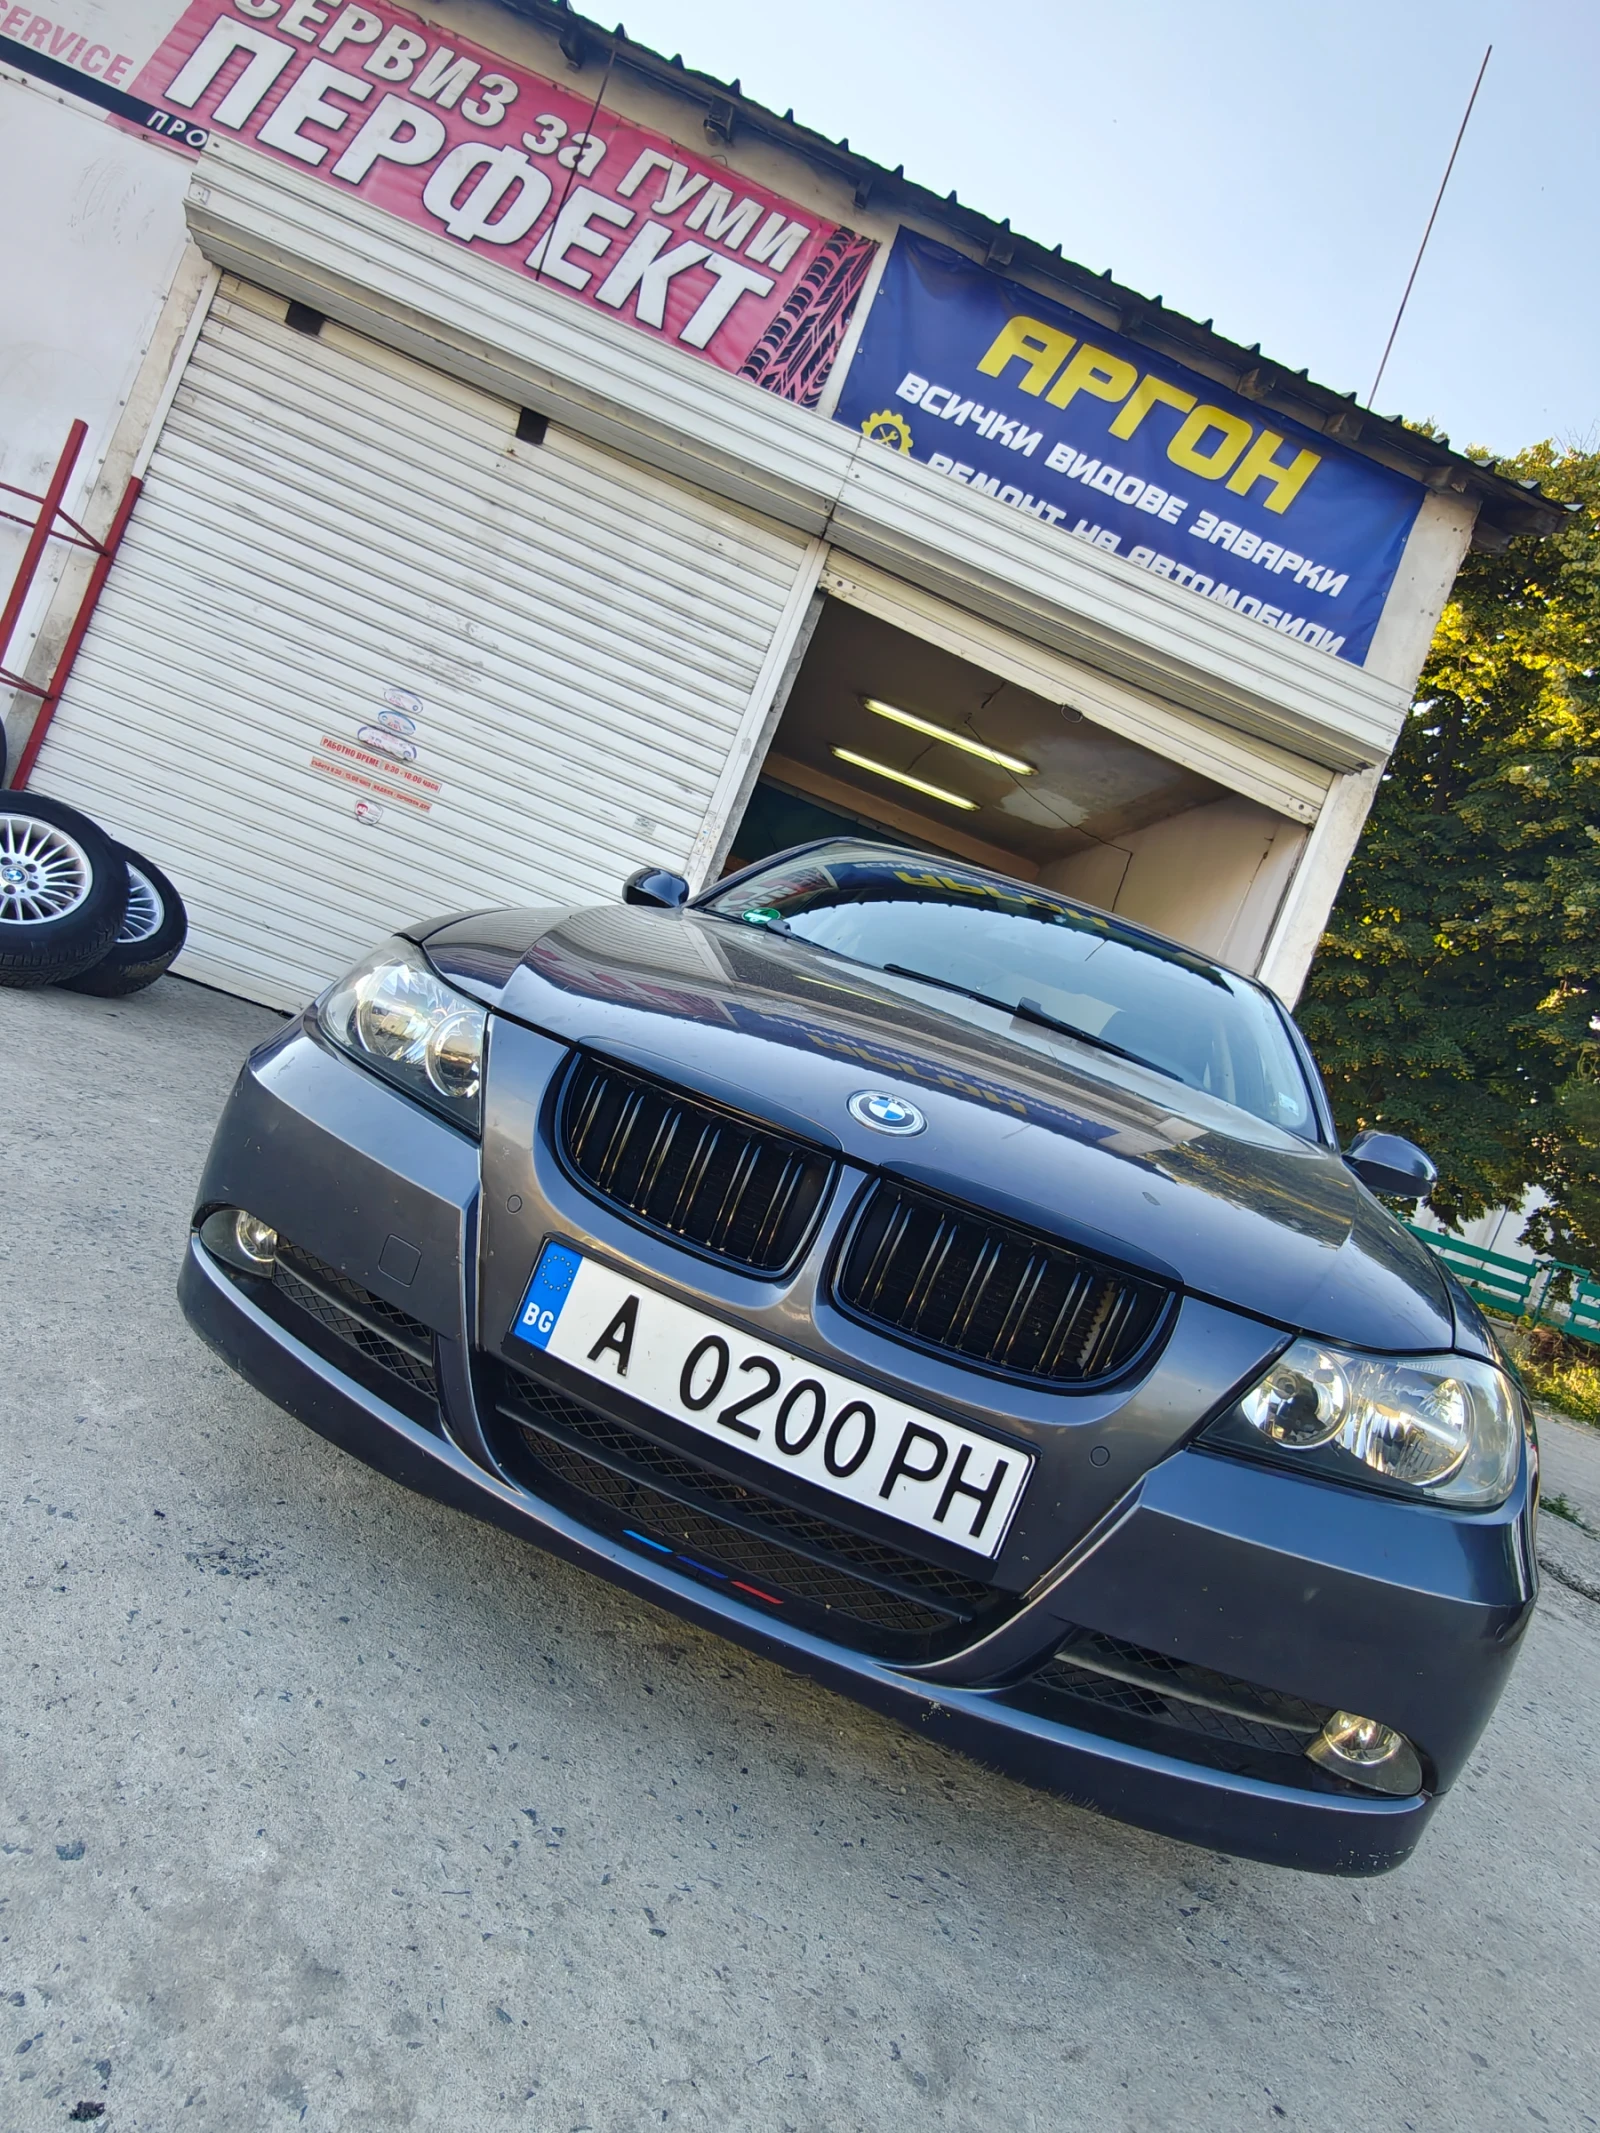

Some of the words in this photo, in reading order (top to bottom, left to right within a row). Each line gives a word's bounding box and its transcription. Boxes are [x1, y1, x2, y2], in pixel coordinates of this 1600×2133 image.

[0, 0, 134, 85] ERVICE
[163, 13, 775, 350] ПЕРФЕКТ
[522, 114, 607, 178] за
[616, 147, 811, 273] ГУМИ
[895, 372, 1043, 457] ВСИЧКИ
[1044, 442, 1188, 525] ВИДОВЕ
[1188, 510, 1349, 598] ЗАВАРКИ
[976, 315, 1321, 515] АРГОН
[323, 738, 356, 757] РАБОТНО
[356, 751, 379, 768] ВРЕМЕ
[522, 1301, 553, 1333] BG
[680, 1335, 877, 1478] 0200
